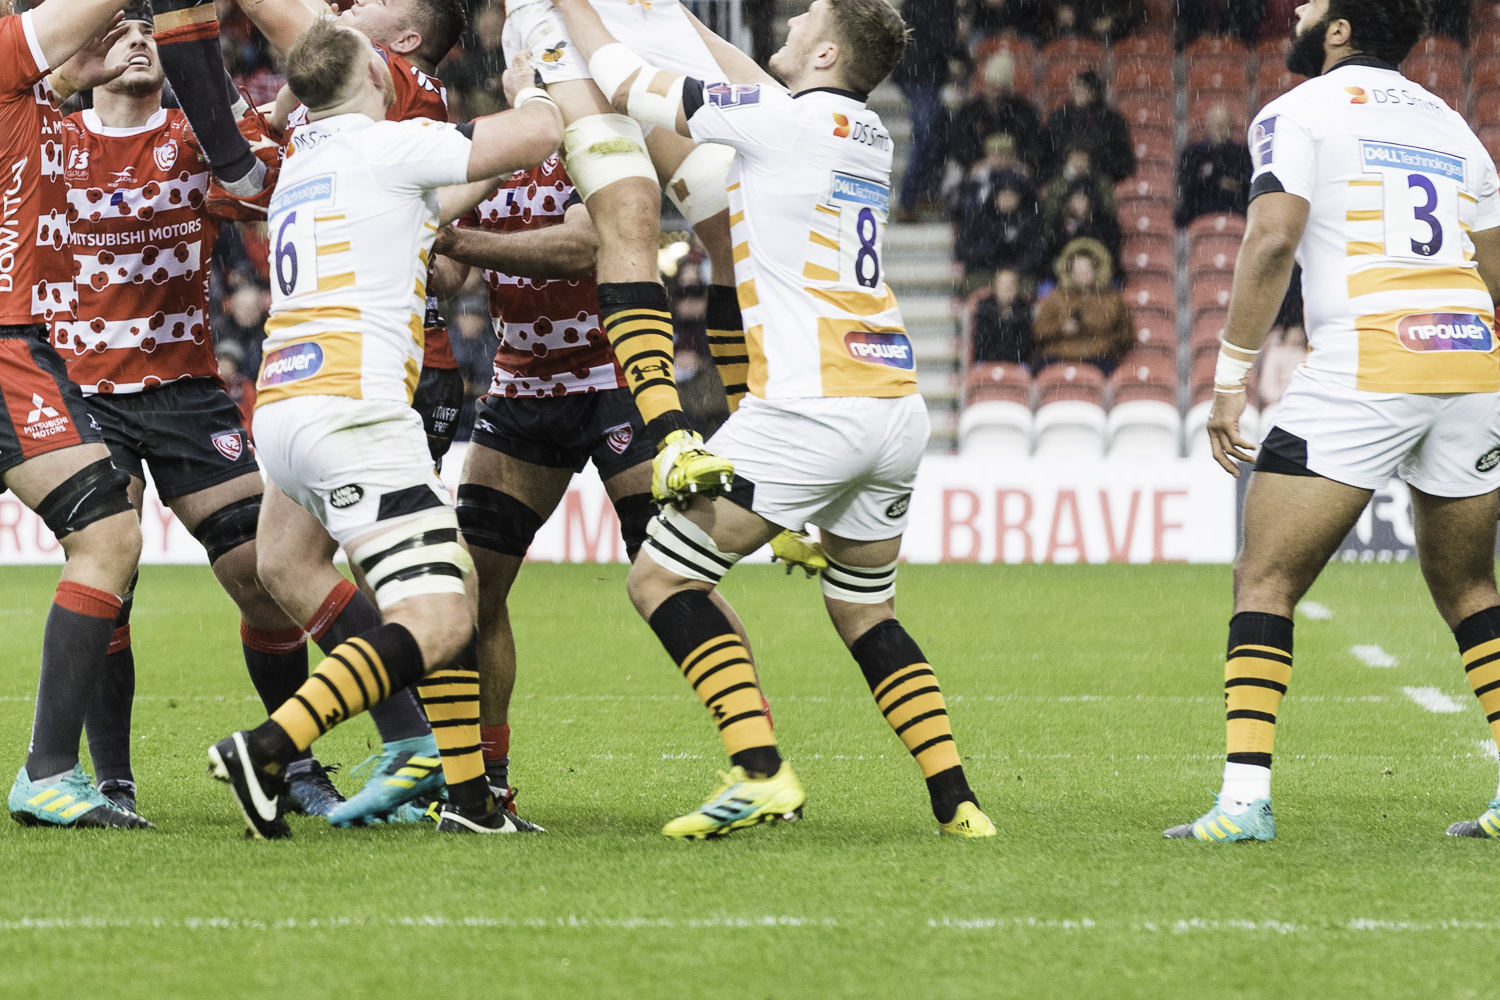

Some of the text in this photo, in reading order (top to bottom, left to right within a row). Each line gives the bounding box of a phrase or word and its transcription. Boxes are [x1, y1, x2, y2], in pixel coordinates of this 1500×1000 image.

[1372, 88, 1401, 104] DS
[852, 121, 870, 144] DS
[1364, 146, 1463, 177] DELL Technologies
[1408, 173, 1443, 257] 3
[70, 218, 202, 247] MITSUBISHI MOTORS
[275, 211, 298, 297] 6
[855, 207, 879, 288] 8
[1407, 324, 1485, 340] npower
[850, 334, 909, 360] npower
[23, 416, 69, 435] MITSUBISHI
[32, 425, 67, 440] MOTORS
[941, 489, 1190, 562] BRAVE
